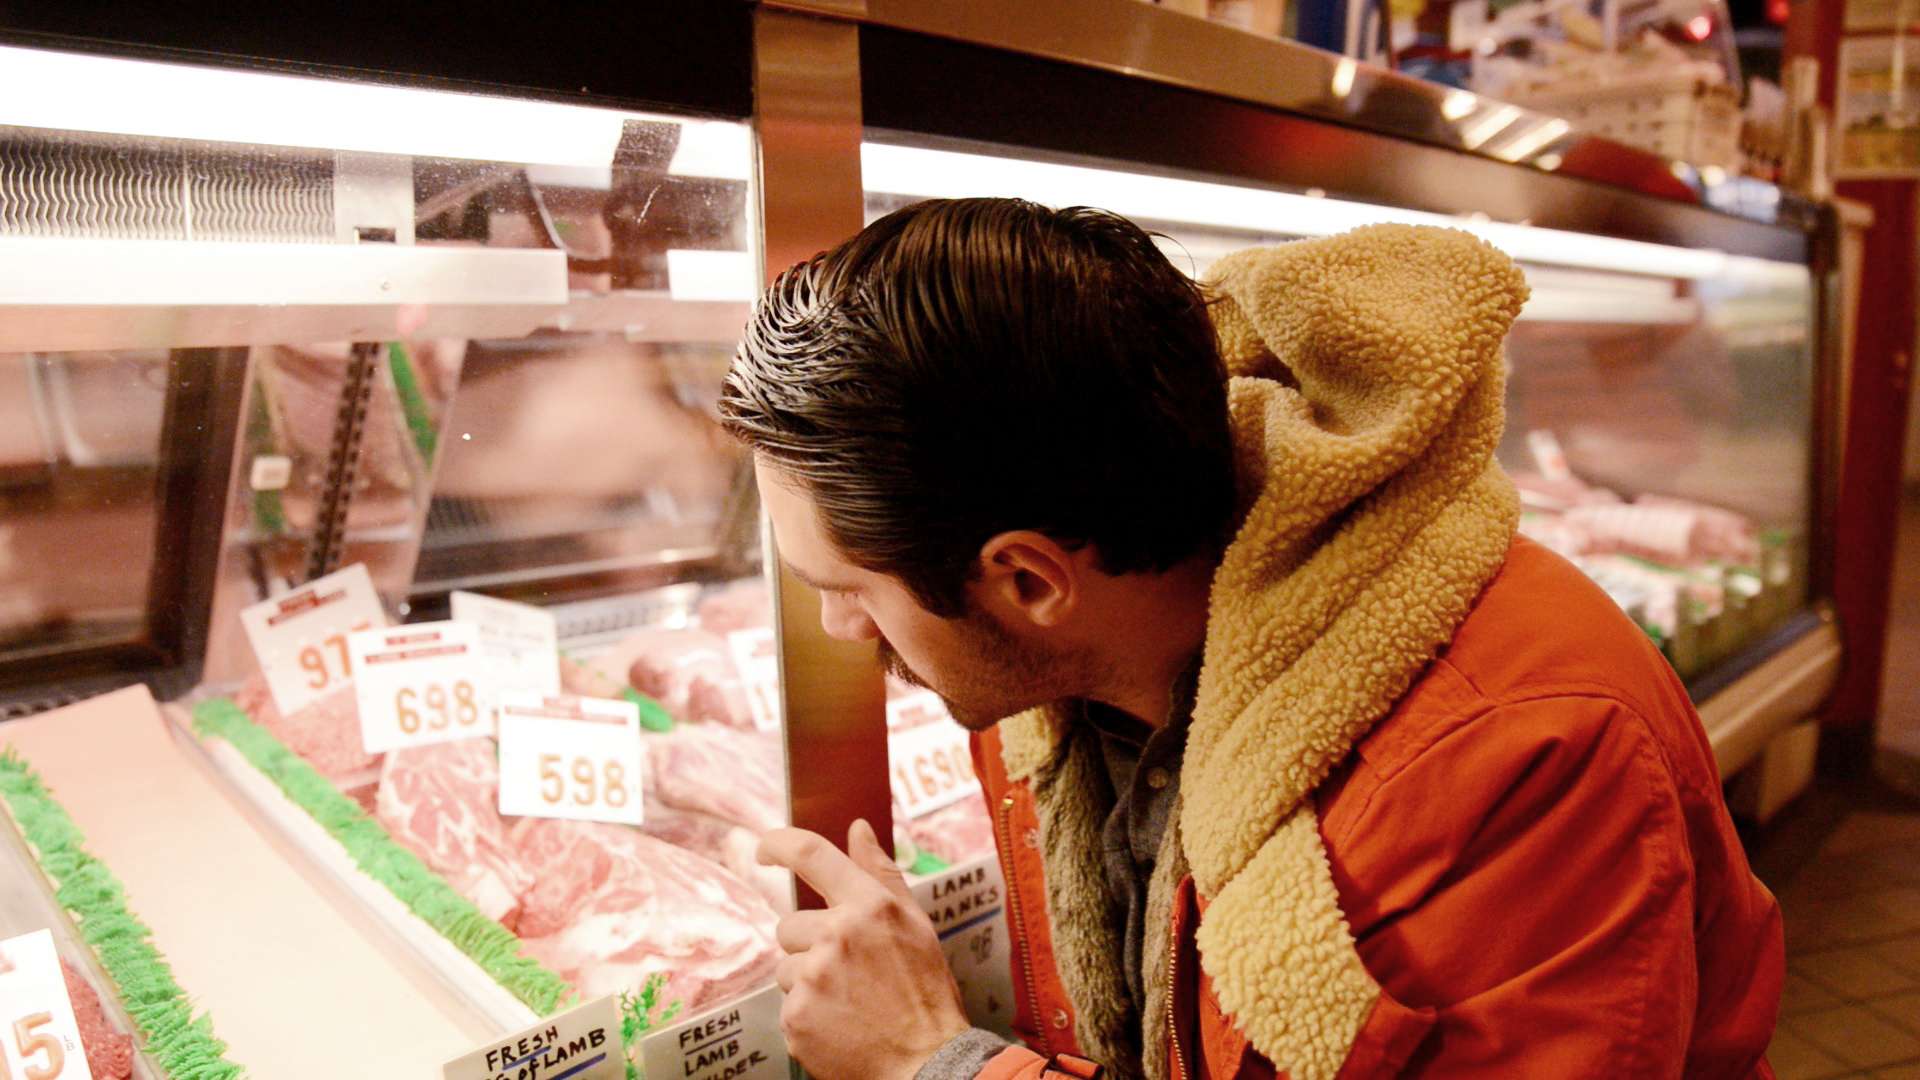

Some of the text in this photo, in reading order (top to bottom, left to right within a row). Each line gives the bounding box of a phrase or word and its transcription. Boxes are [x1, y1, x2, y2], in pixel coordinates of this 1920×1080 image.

[299, 621, 368, 690] 97
[396, 680, 478, 734] 698
[539, 754, 627, 808] 598
[929, 886, 999, 923] HANKS
[932, 868, 985, 900] LAMB
[486, 1026, 558, 1071] FRESH
[544, 1028, 606, 1069] LAMB
[679, 1010, 741, 1048] FRESH
[685, 1040, 739, 1076] LAMB
